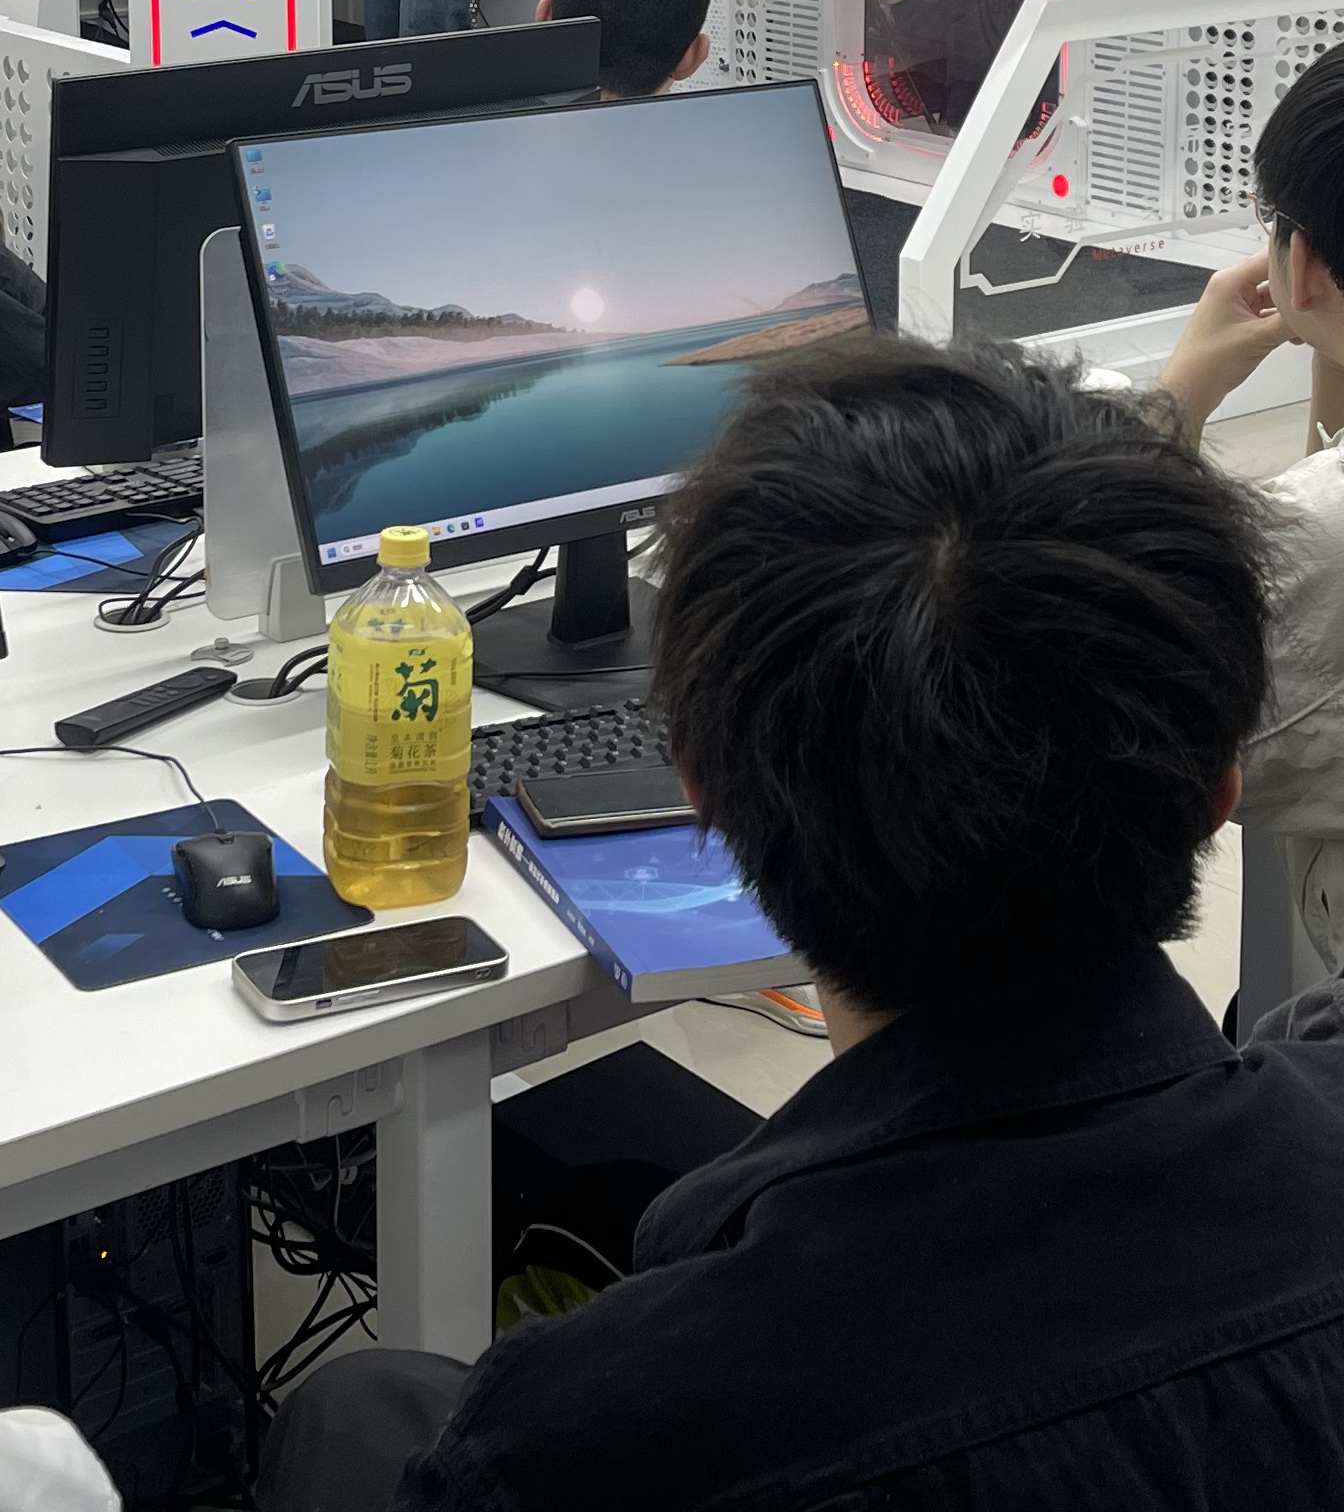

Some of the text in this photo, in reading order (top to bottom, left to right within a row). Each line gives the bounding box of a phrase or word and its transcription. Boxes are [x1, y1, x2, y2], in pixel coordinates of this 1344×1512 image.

[291, 62, 413, 108] ASUS
[619, 505, 657, 524] ASUS
[391, 657, 440, 723] 菊
[390, 743, 437, 760] 菊花茶
[216, 874, 253, 888] ASUS
